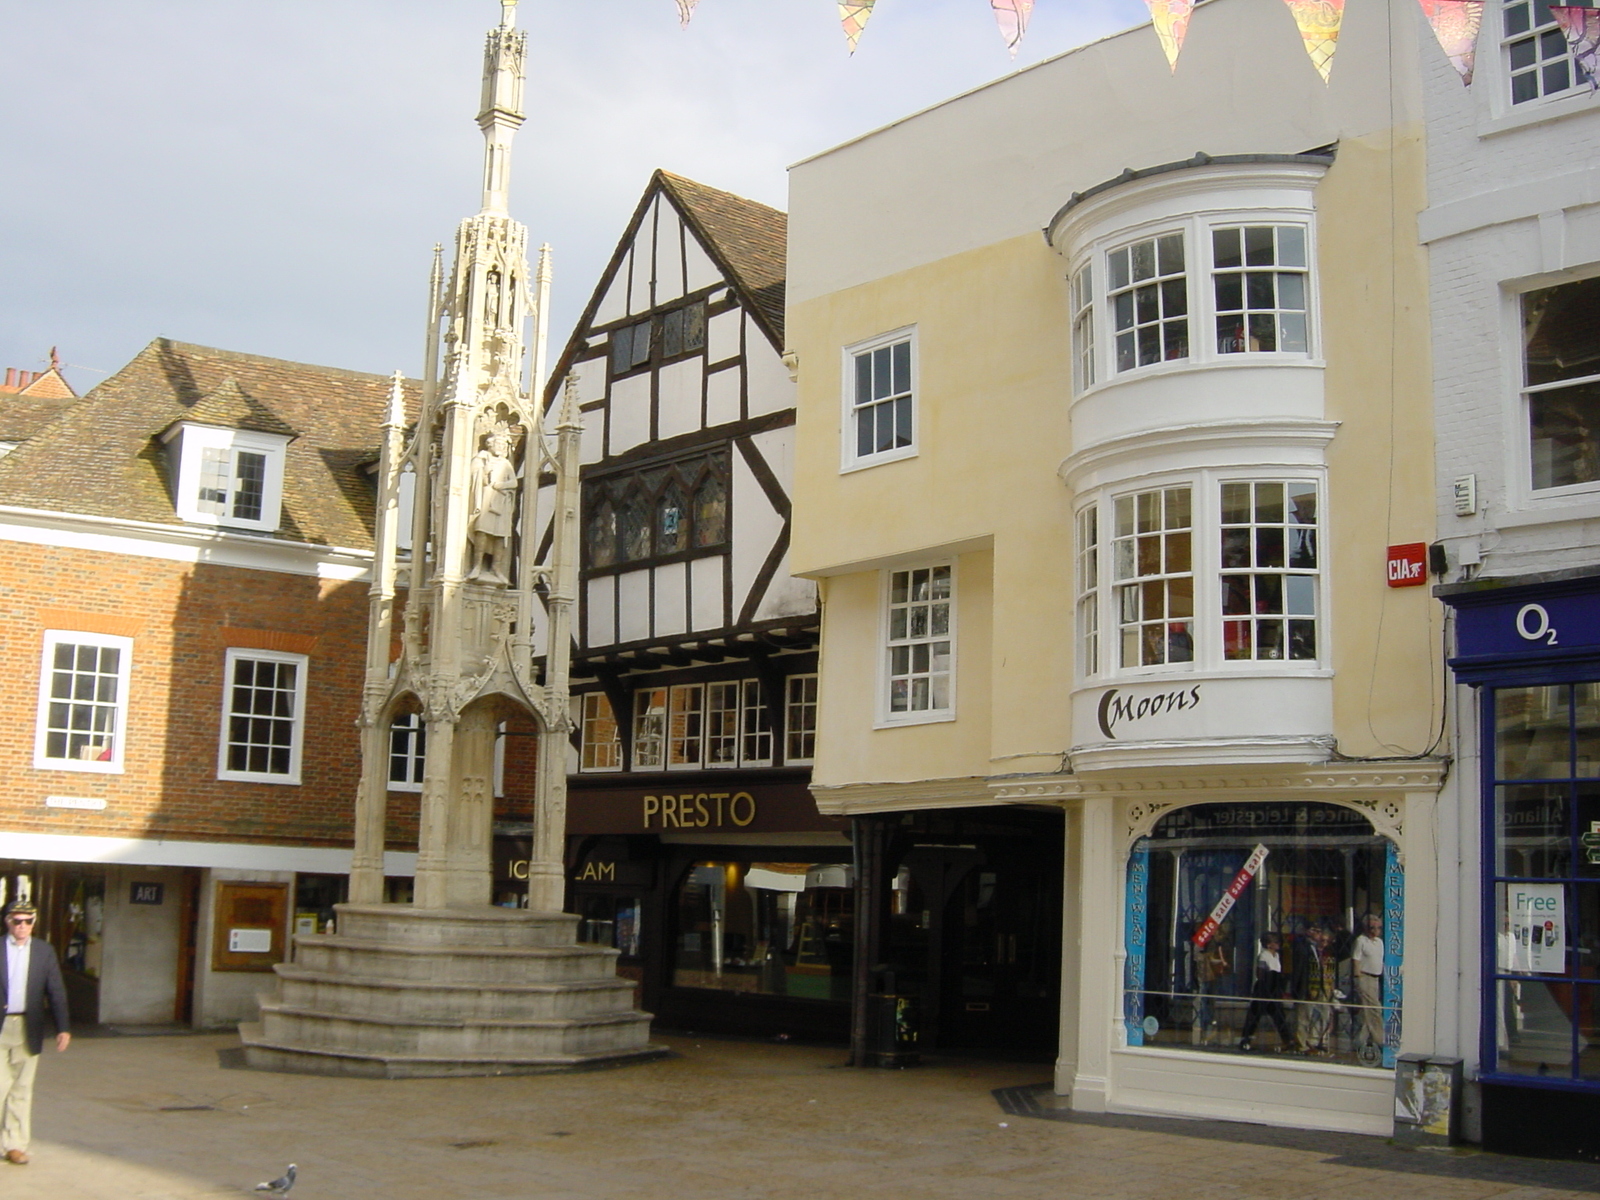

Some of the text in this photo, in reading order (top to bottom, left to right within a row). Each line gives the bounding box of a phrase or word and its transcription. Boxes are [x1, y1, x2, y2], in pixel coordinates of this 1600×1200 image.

[1388, 559, 1411, 581] CIA
[1516, 603, 1559, 646] O2
[1109, 684, 1201, 730] Moons
[643, 791, 756, 828] PRESTO
[509, 860, 531, 879] IC
[136, 886, 158, 901] ART
[1131, 863, 1146, 947] MENSWEAR
[1198, 849, 1265, 943] sale sale sale sale
[1388, 864, 1404, 957] MENSWEAR
[1516, 892, 1557, 911] Free
[1130, 954, 1143, 1039] UPSTAIRS
